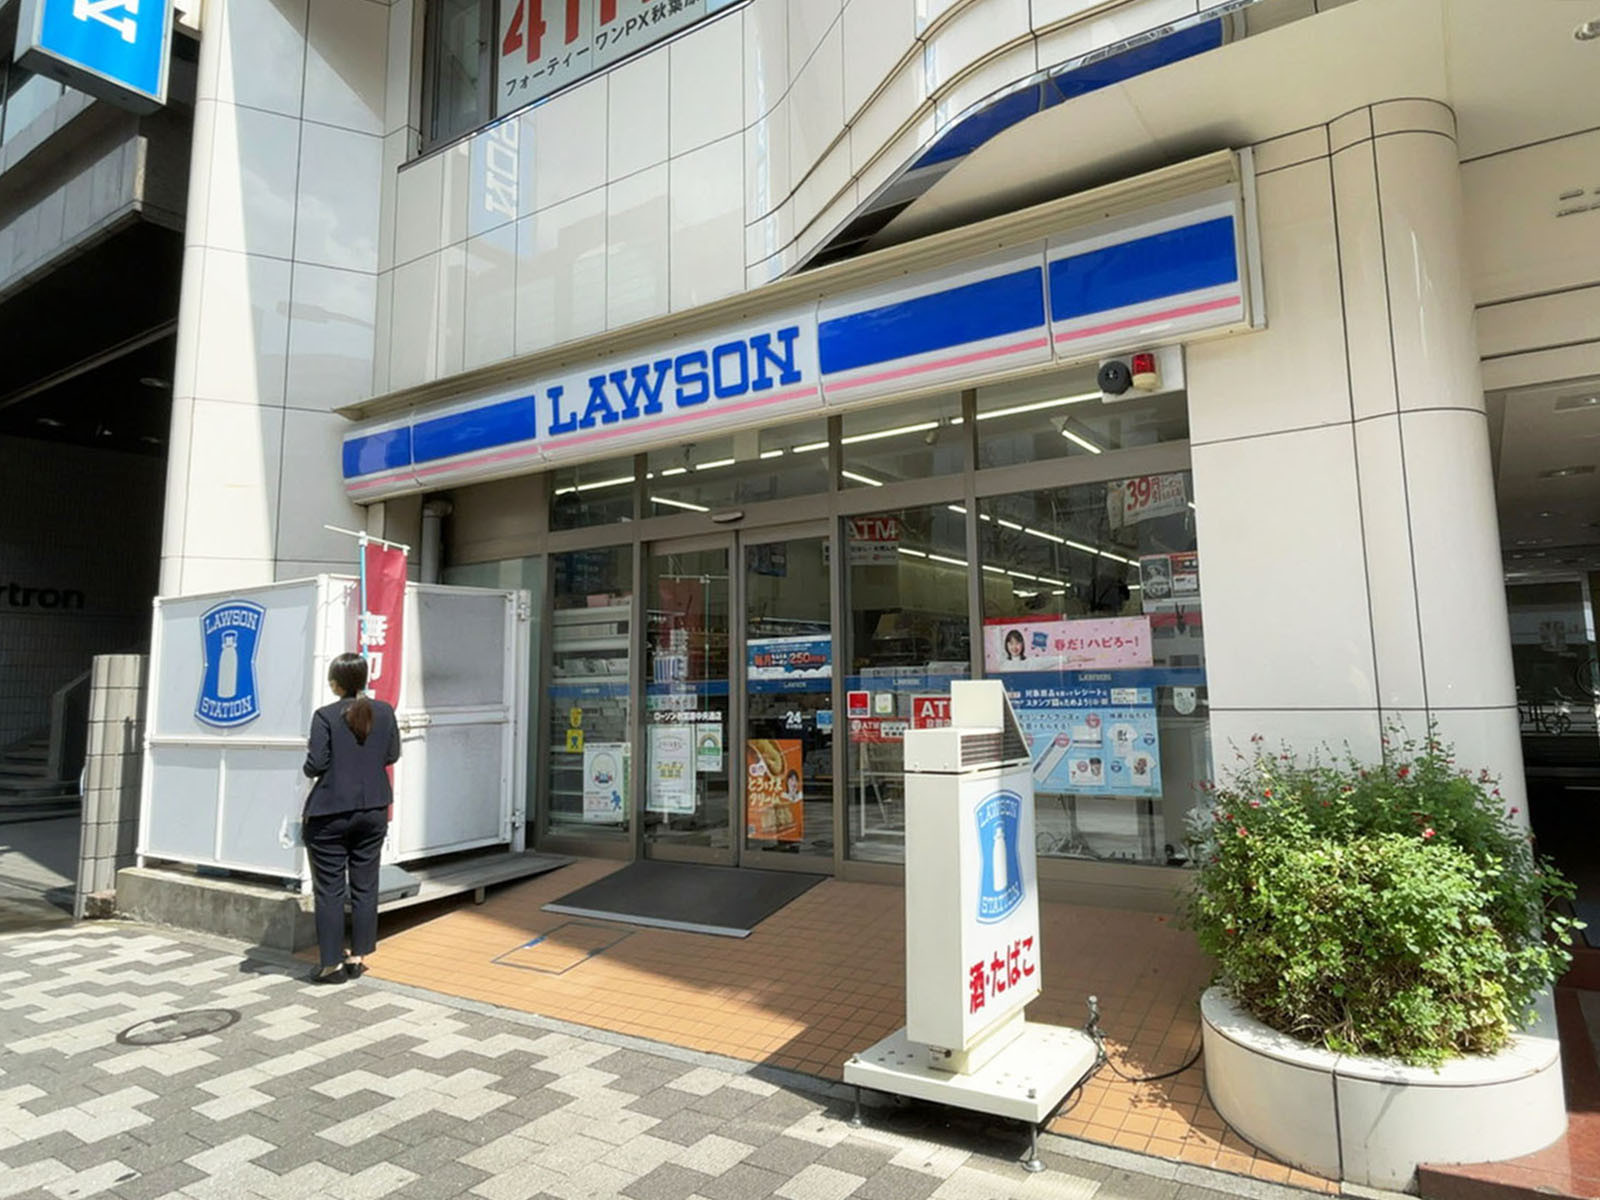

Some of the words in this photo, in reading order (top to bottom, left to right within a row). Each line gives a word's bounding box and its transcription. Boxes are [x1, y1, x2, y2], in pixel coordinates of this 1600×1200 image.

[547, 326, 802, 436] LAWSON
[205, 609, 259, 636] LAWSON
[200, 694, 253, 718] STATION
[921, 700, 949, 718] AT
[969, 935, 1035, 1014] 酒・たばこ
